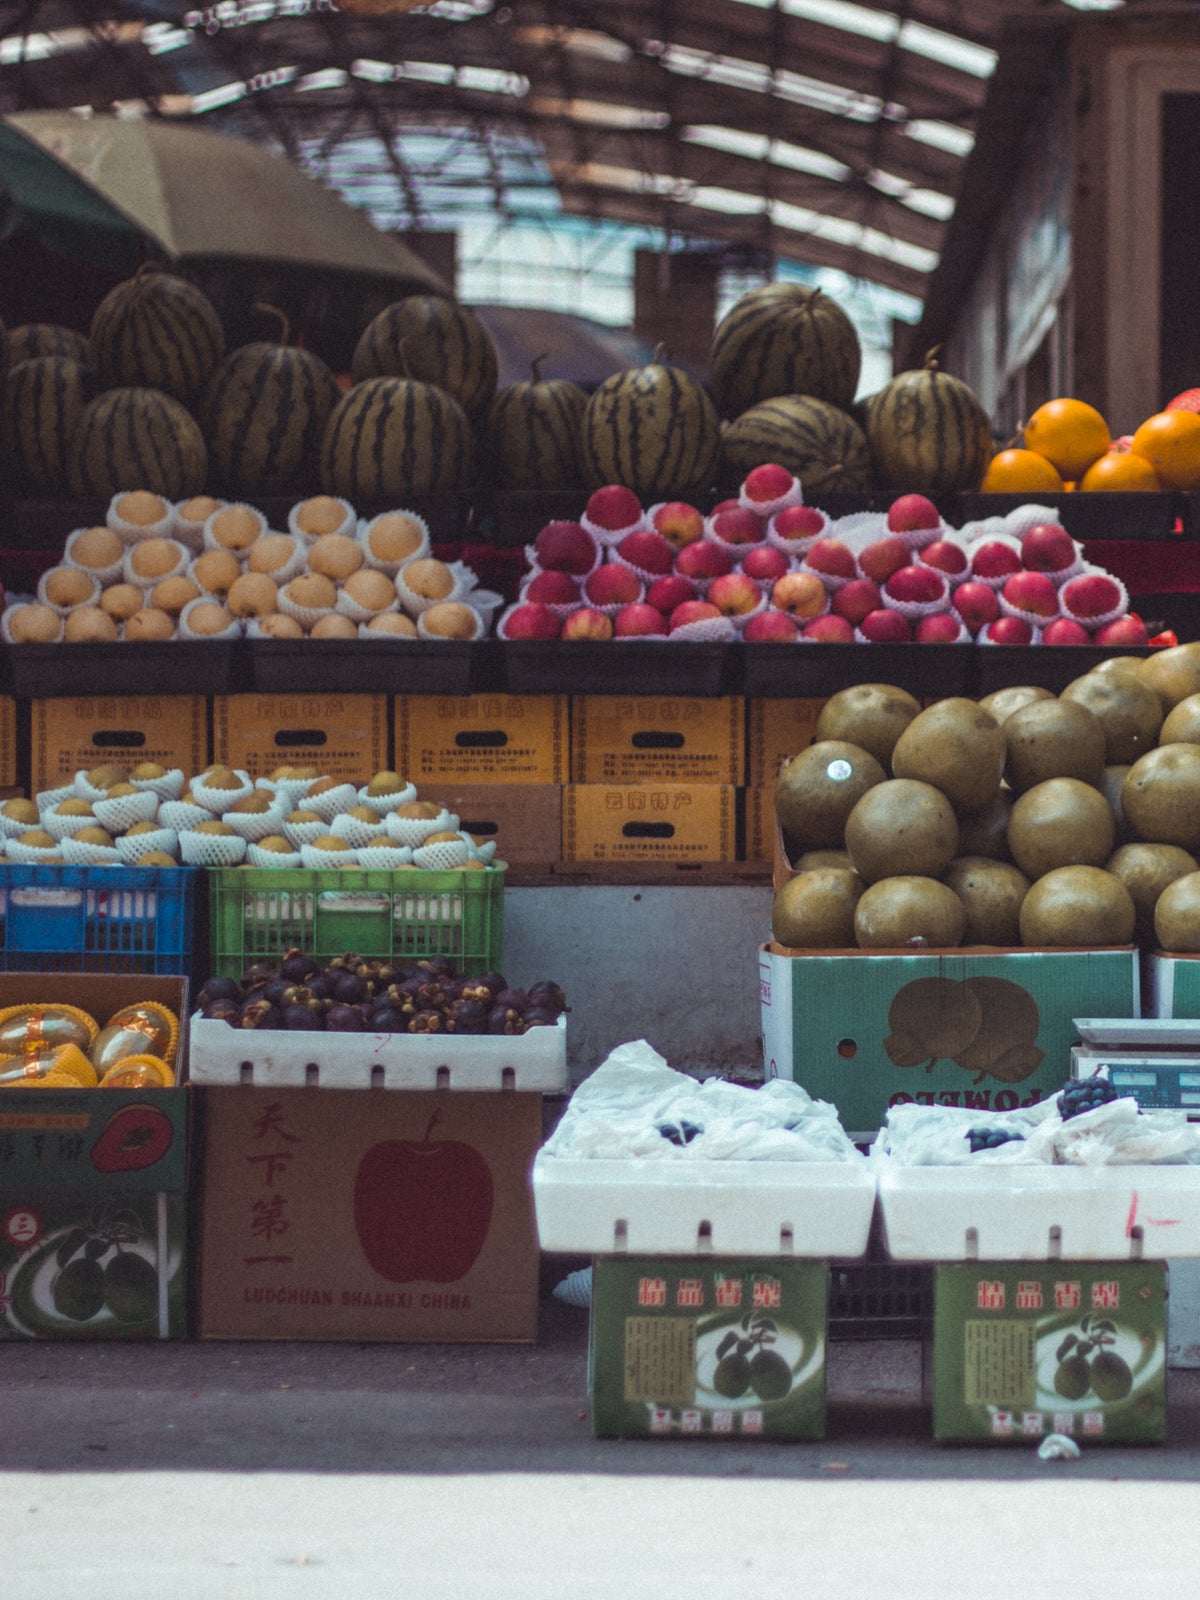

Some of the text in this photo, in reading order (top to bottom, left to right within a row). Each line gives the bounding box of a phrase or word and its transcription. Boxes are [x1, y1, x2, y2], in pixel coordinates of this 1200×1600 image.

[243, 1102, 301, 1265] 天下第一
[242, 1287, 471, 1310] LUOCHUAN SHAANXI CHINA
[638, 1277, 781, 1308] 精品香梨
[977, 1280, 1120, 1309] 精品香梨
